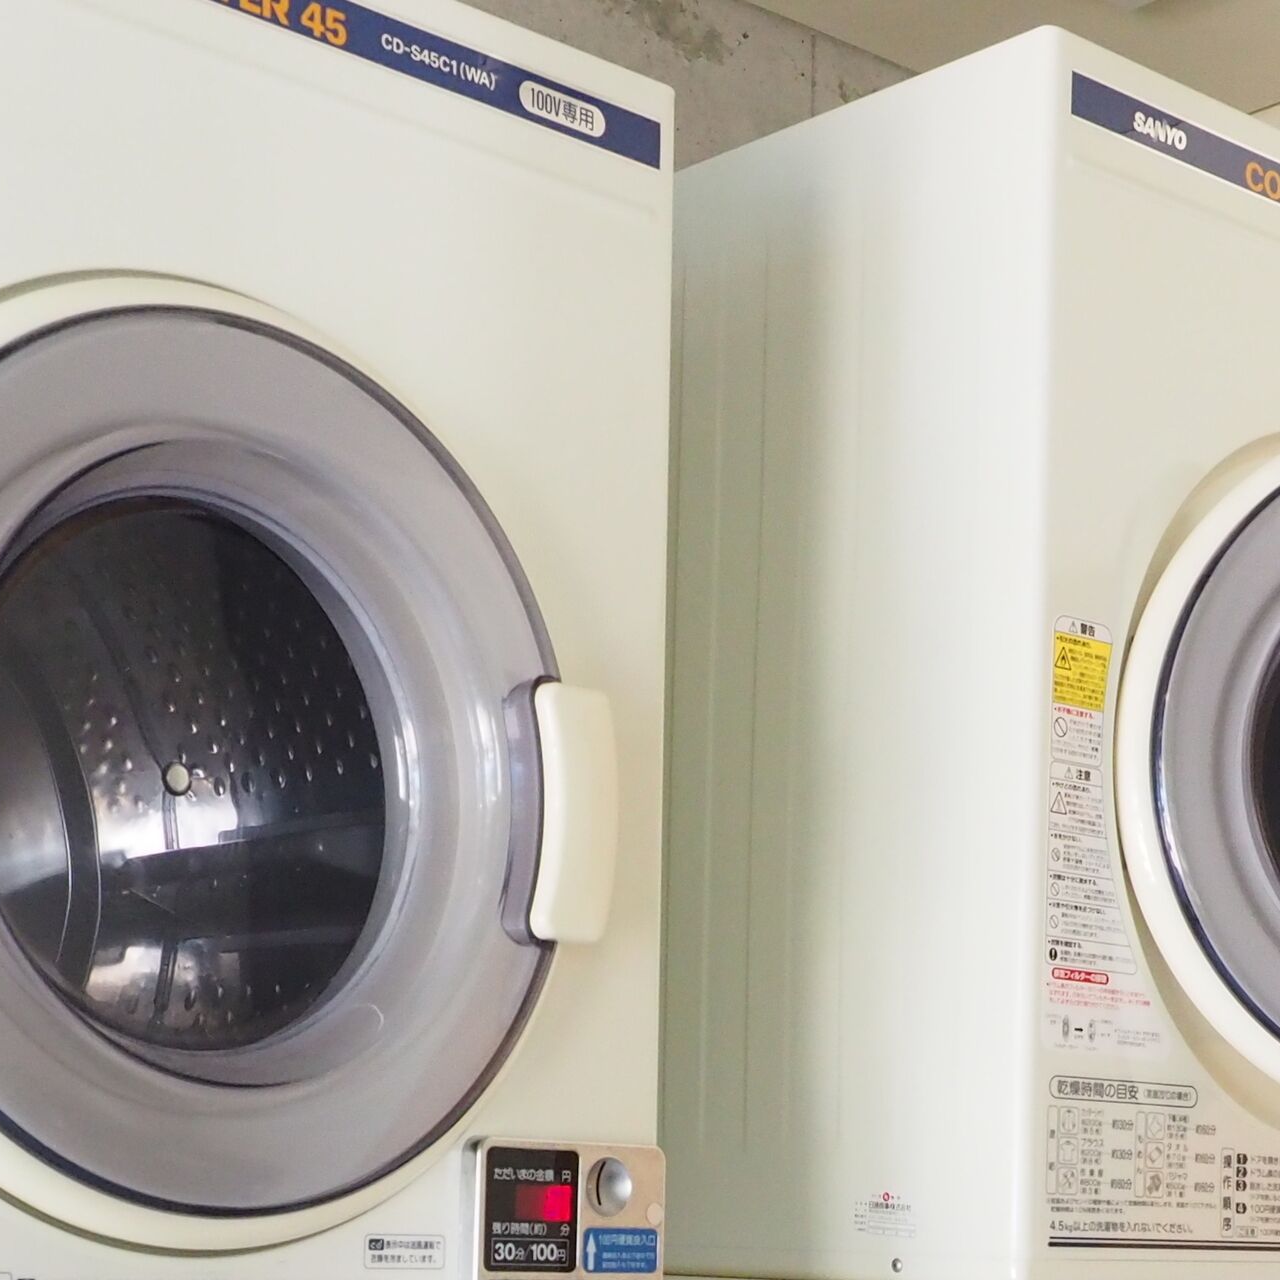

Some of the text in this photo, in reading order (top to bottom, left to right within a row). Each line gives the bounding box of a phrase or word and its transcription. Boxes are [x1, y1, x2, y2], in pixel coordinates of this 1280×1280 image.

[301, 2, 348, 47] 45
[381, 33, 496, 90] CD-S45C1(WA)
[530, 87, 595, 132] 100V専用
[1133, 111, 1188, 151] SANYO
[1080, 622, 1096, 637] 警告
[1076, 769, 1091, 782] 注意
[1057, 1080, 1139, 1101] 乾燥時間の目安
[493, 1168, 572, 1184] ただいまの金額 円
[559, 1225, 571, 1237] 分
